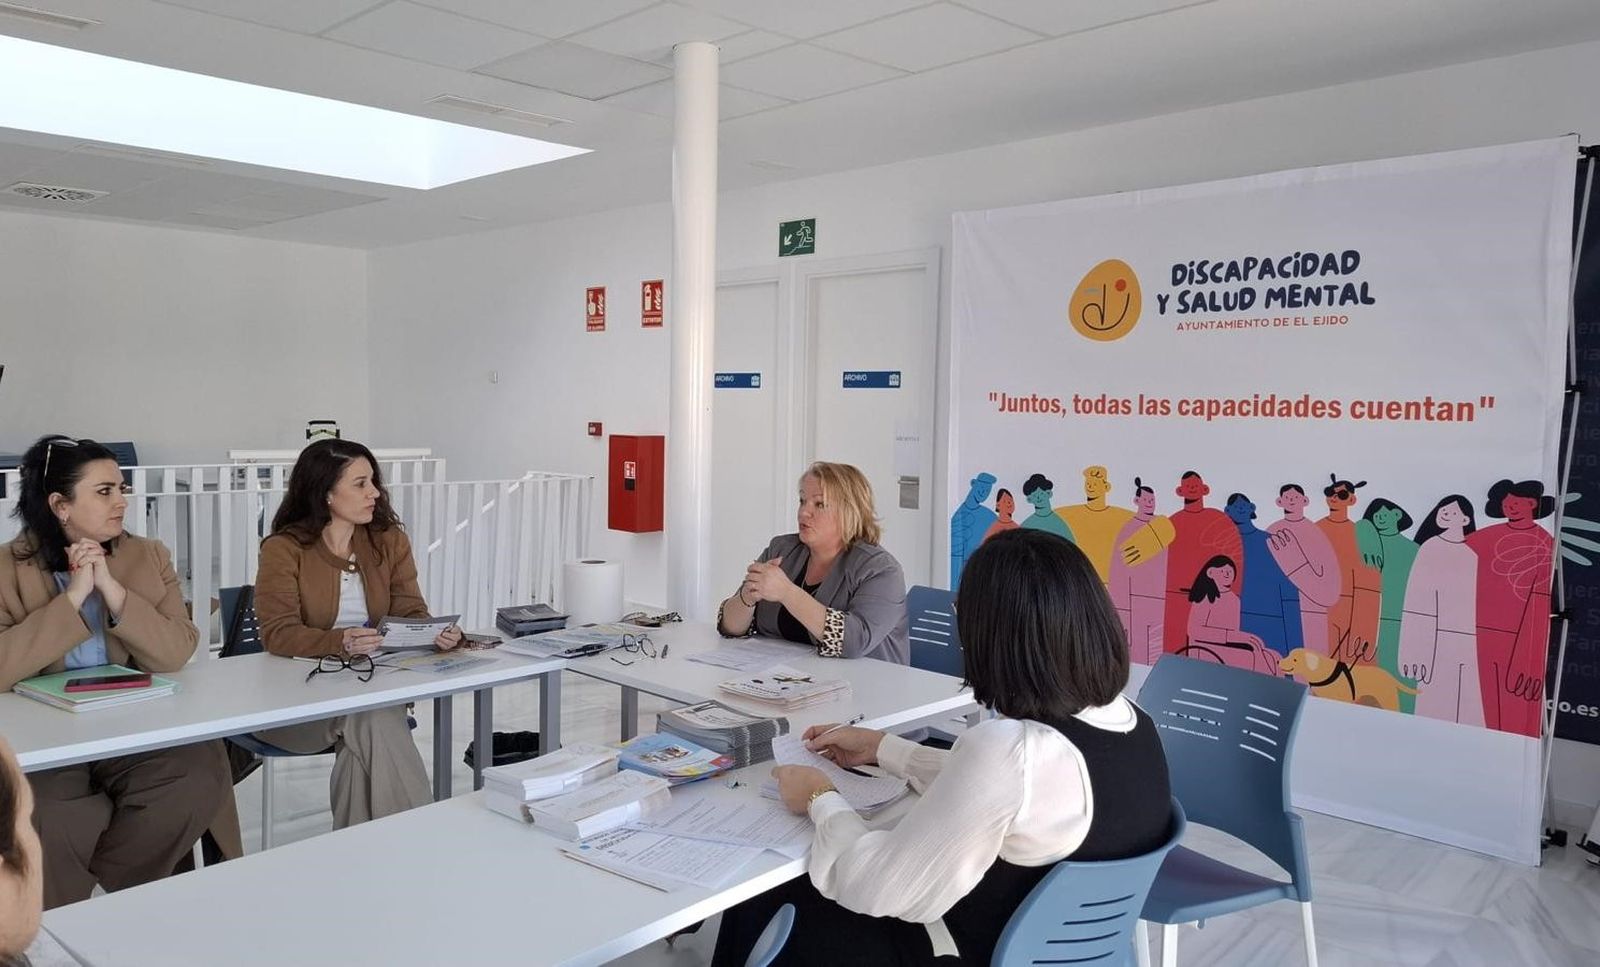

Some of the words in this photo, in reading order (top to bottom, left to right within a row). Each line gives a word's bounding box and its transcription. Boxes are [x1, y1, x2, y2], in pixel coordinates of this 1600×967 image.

[1156, 293, 1170, 315] Y
[1176, 286, 1257, 314] SALUD
[1264, 281, 1376, 309] MENTAL
[1176, 317, 1270, 331] AYUNTAMIENTO
[1273, 316, 1290, 327] DE
[1293, 316, 1310, 326] EL
[1313, 314, 1349, 326] EJIDO
[989, 392, 1067, 418] "Juntos,
[1073, 393, 1132, 415] todas
[1138, 394, 1172, 416] las
[1177, 394, 1342, 421] capacidades
